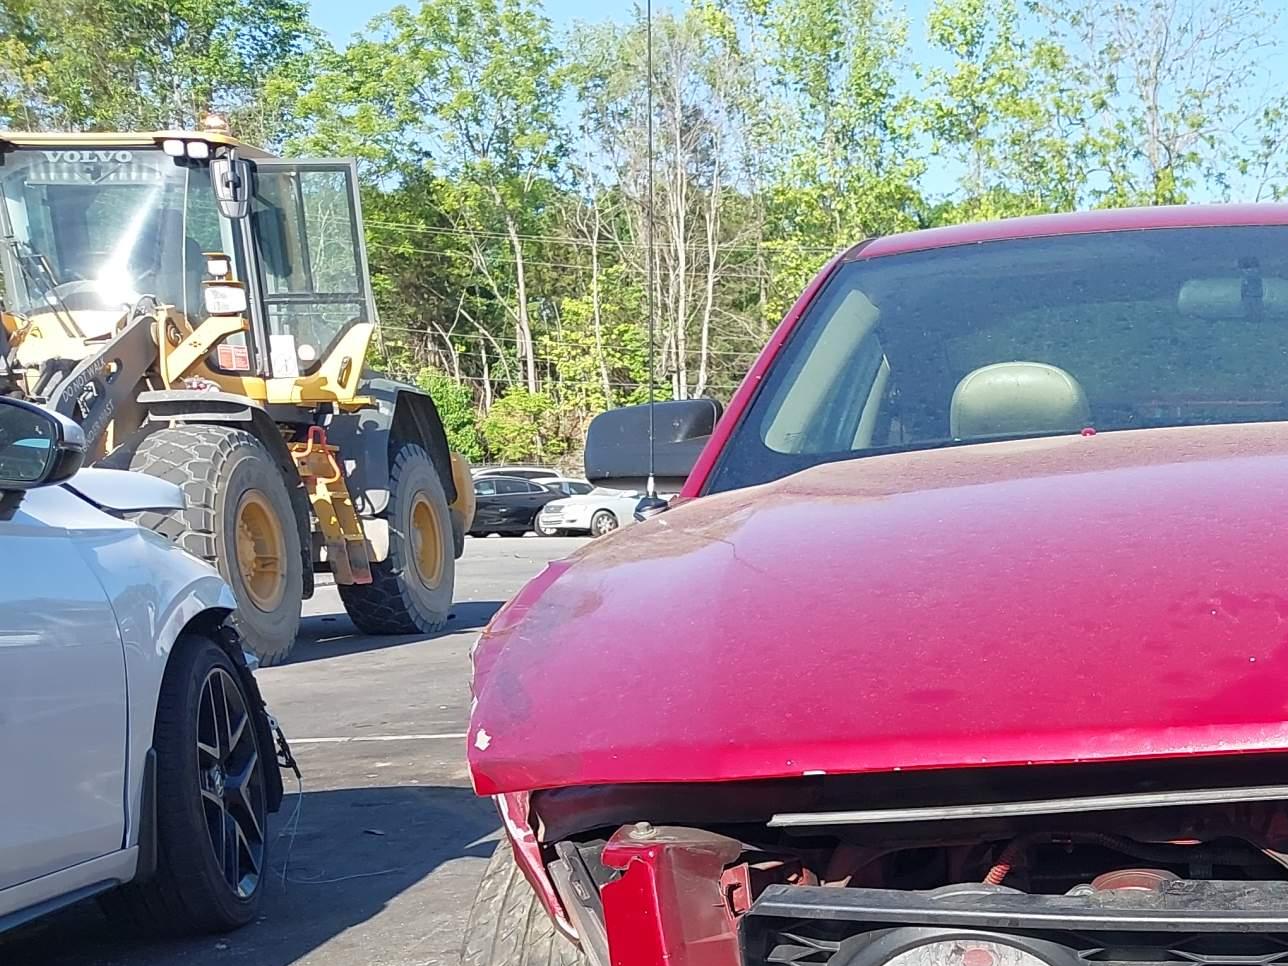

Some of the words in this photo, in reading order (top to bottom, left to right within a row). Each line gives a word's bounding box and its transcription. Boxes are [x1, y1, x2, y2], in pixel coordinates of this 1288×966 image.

[42, 151, 132, 162] VOLVO
[62, 387, 74, 402] DO
[74, 372, 89, 391] NOT
[87, 356, 106, 377] WALK
